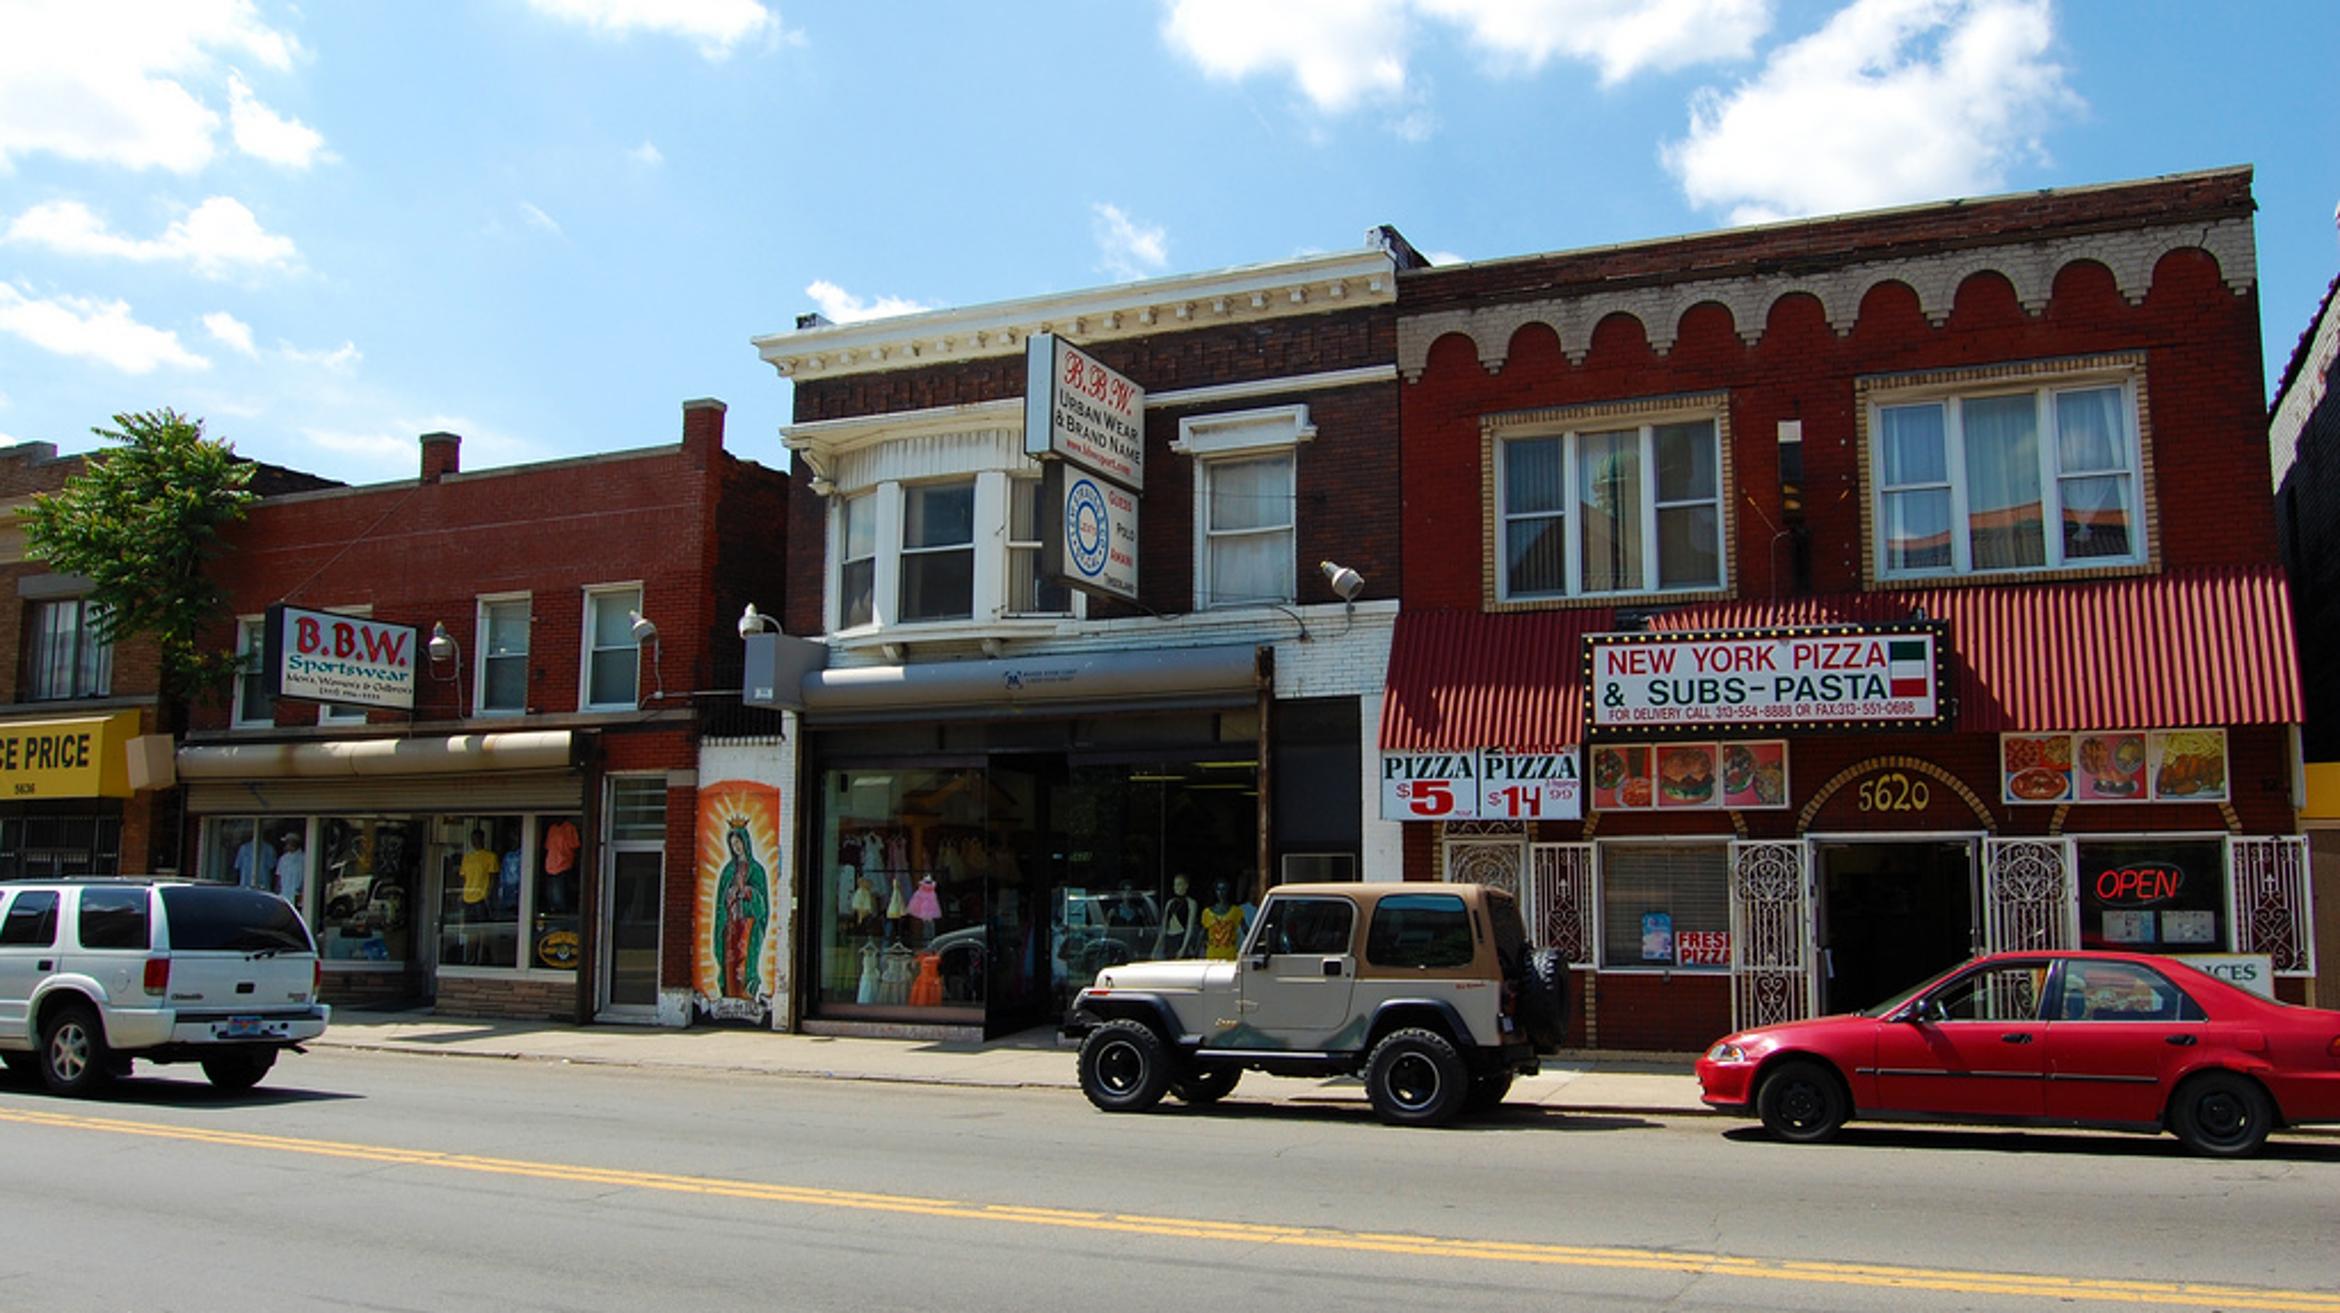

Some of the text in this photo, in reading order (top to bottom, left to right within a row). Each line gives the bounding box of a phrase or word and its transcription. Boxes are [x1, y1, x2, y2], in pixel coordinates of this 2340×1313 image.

[1064, 350, 1136, 416] B.B.W.
[1060, 388, 1138, 443] URBAN WEAR
[1055, 409, 1141, 466] & BRAND NAME
[295, 616, 408, 667] B.B.W.
[1608, 641, 1886, 675] NEW YORK PIZZA
[288, 655, 409, 682] Sportswear
[1604, 682, 1625, 707] &
[1609, 709, 1630, 721] FOR
[1634, 708, 1682, 720] DELIVERY
[1686, 706, 1711, 719] CALL
[1796, 703, 1811, 717] OR
[0, 733, 90, 770] E PRICE
[1385, 756, 1474, 780] PIZZA
[1485, 756, 1577, 780] PIZZA
[1858, 773, 1929, 812] 5620
[2097, 869, 2178, 899] OPEN
